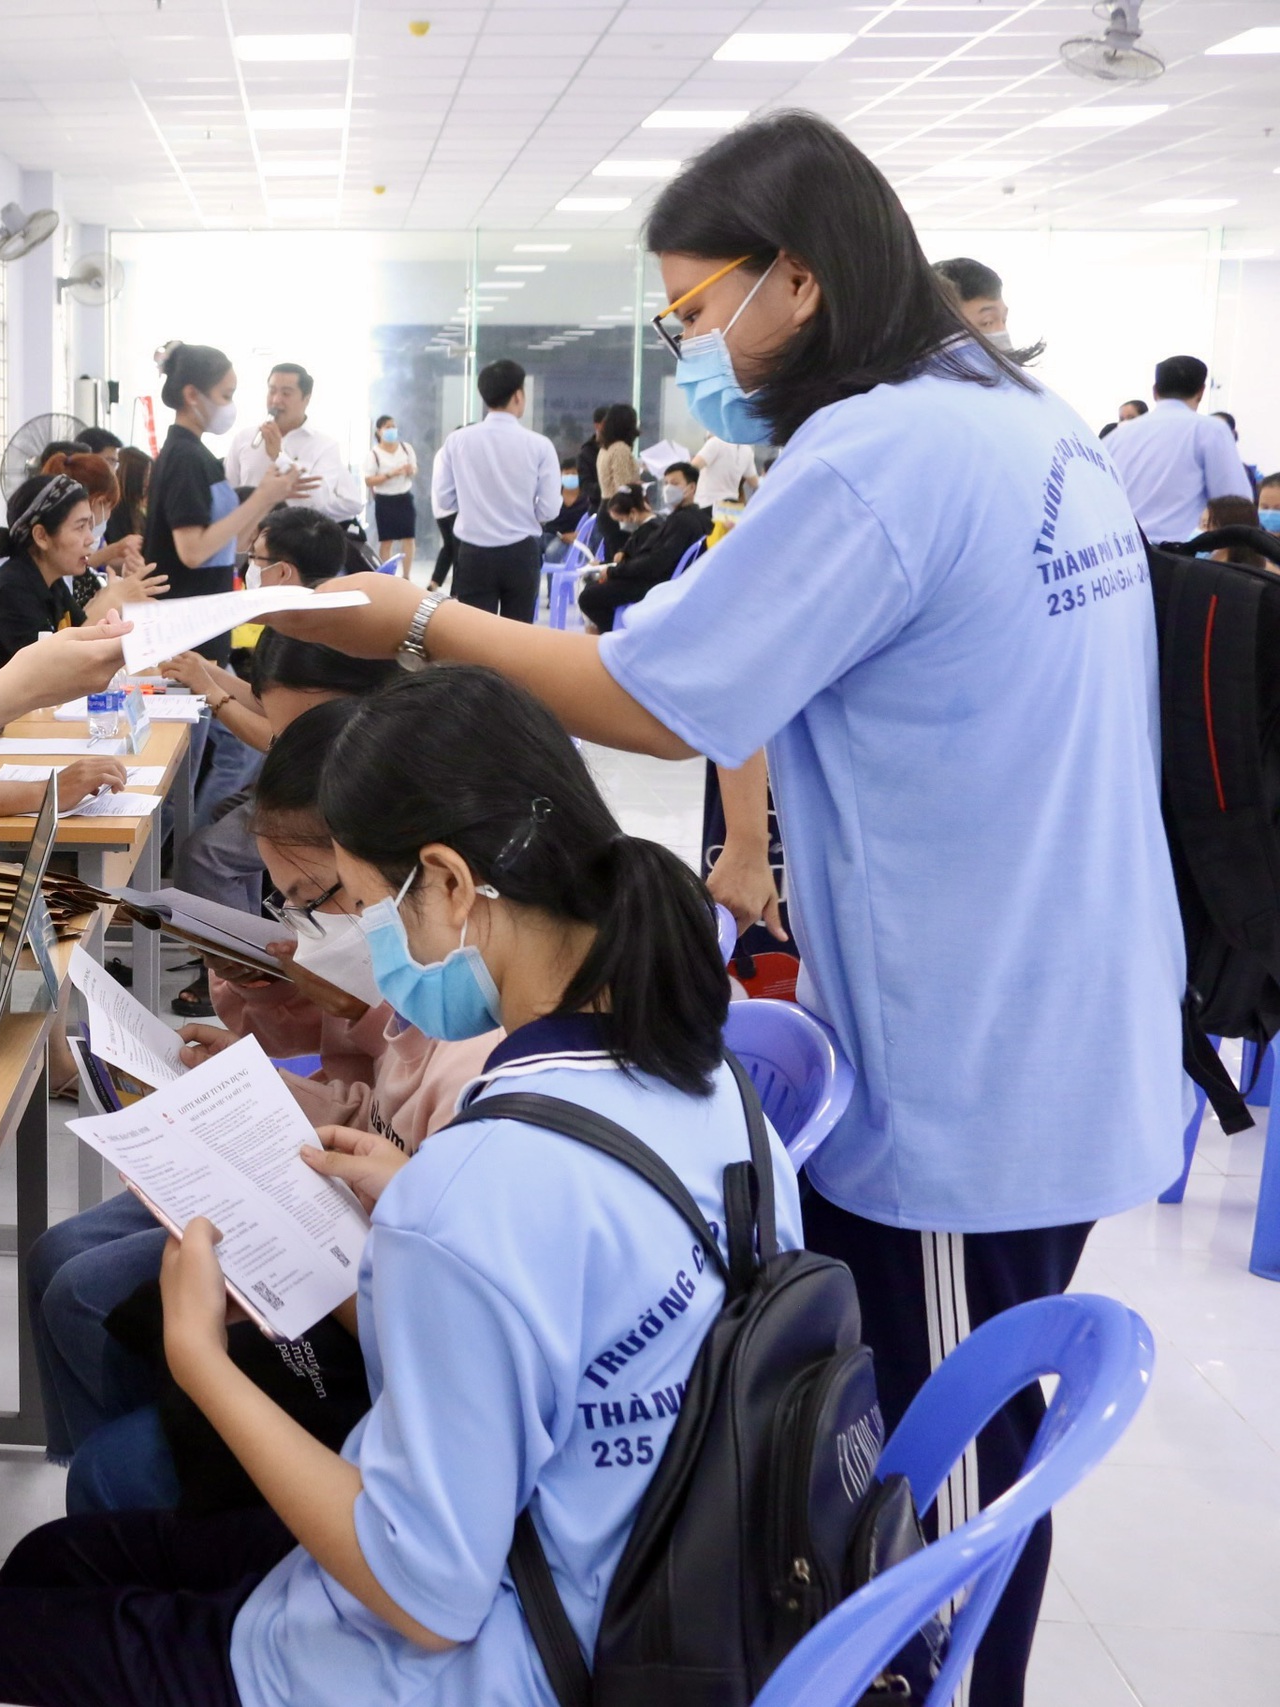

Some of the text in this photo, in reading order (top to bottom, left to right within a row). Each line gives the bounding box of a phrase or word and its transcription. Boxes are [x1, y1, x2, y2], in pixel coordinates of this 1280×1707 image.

[1037, 546, 1098, 584] THÀNH
[1047, 584, 1086, 617] 235
[178, 1101, 195, 1115] LOTTE
[194, 1092, 211, 1106] MART
[229, 1068, 249, 1084] DỤNG
[584, 1269, 696, 1390] TRƯỜNG
[591, 1436, 654, 1468] 235
